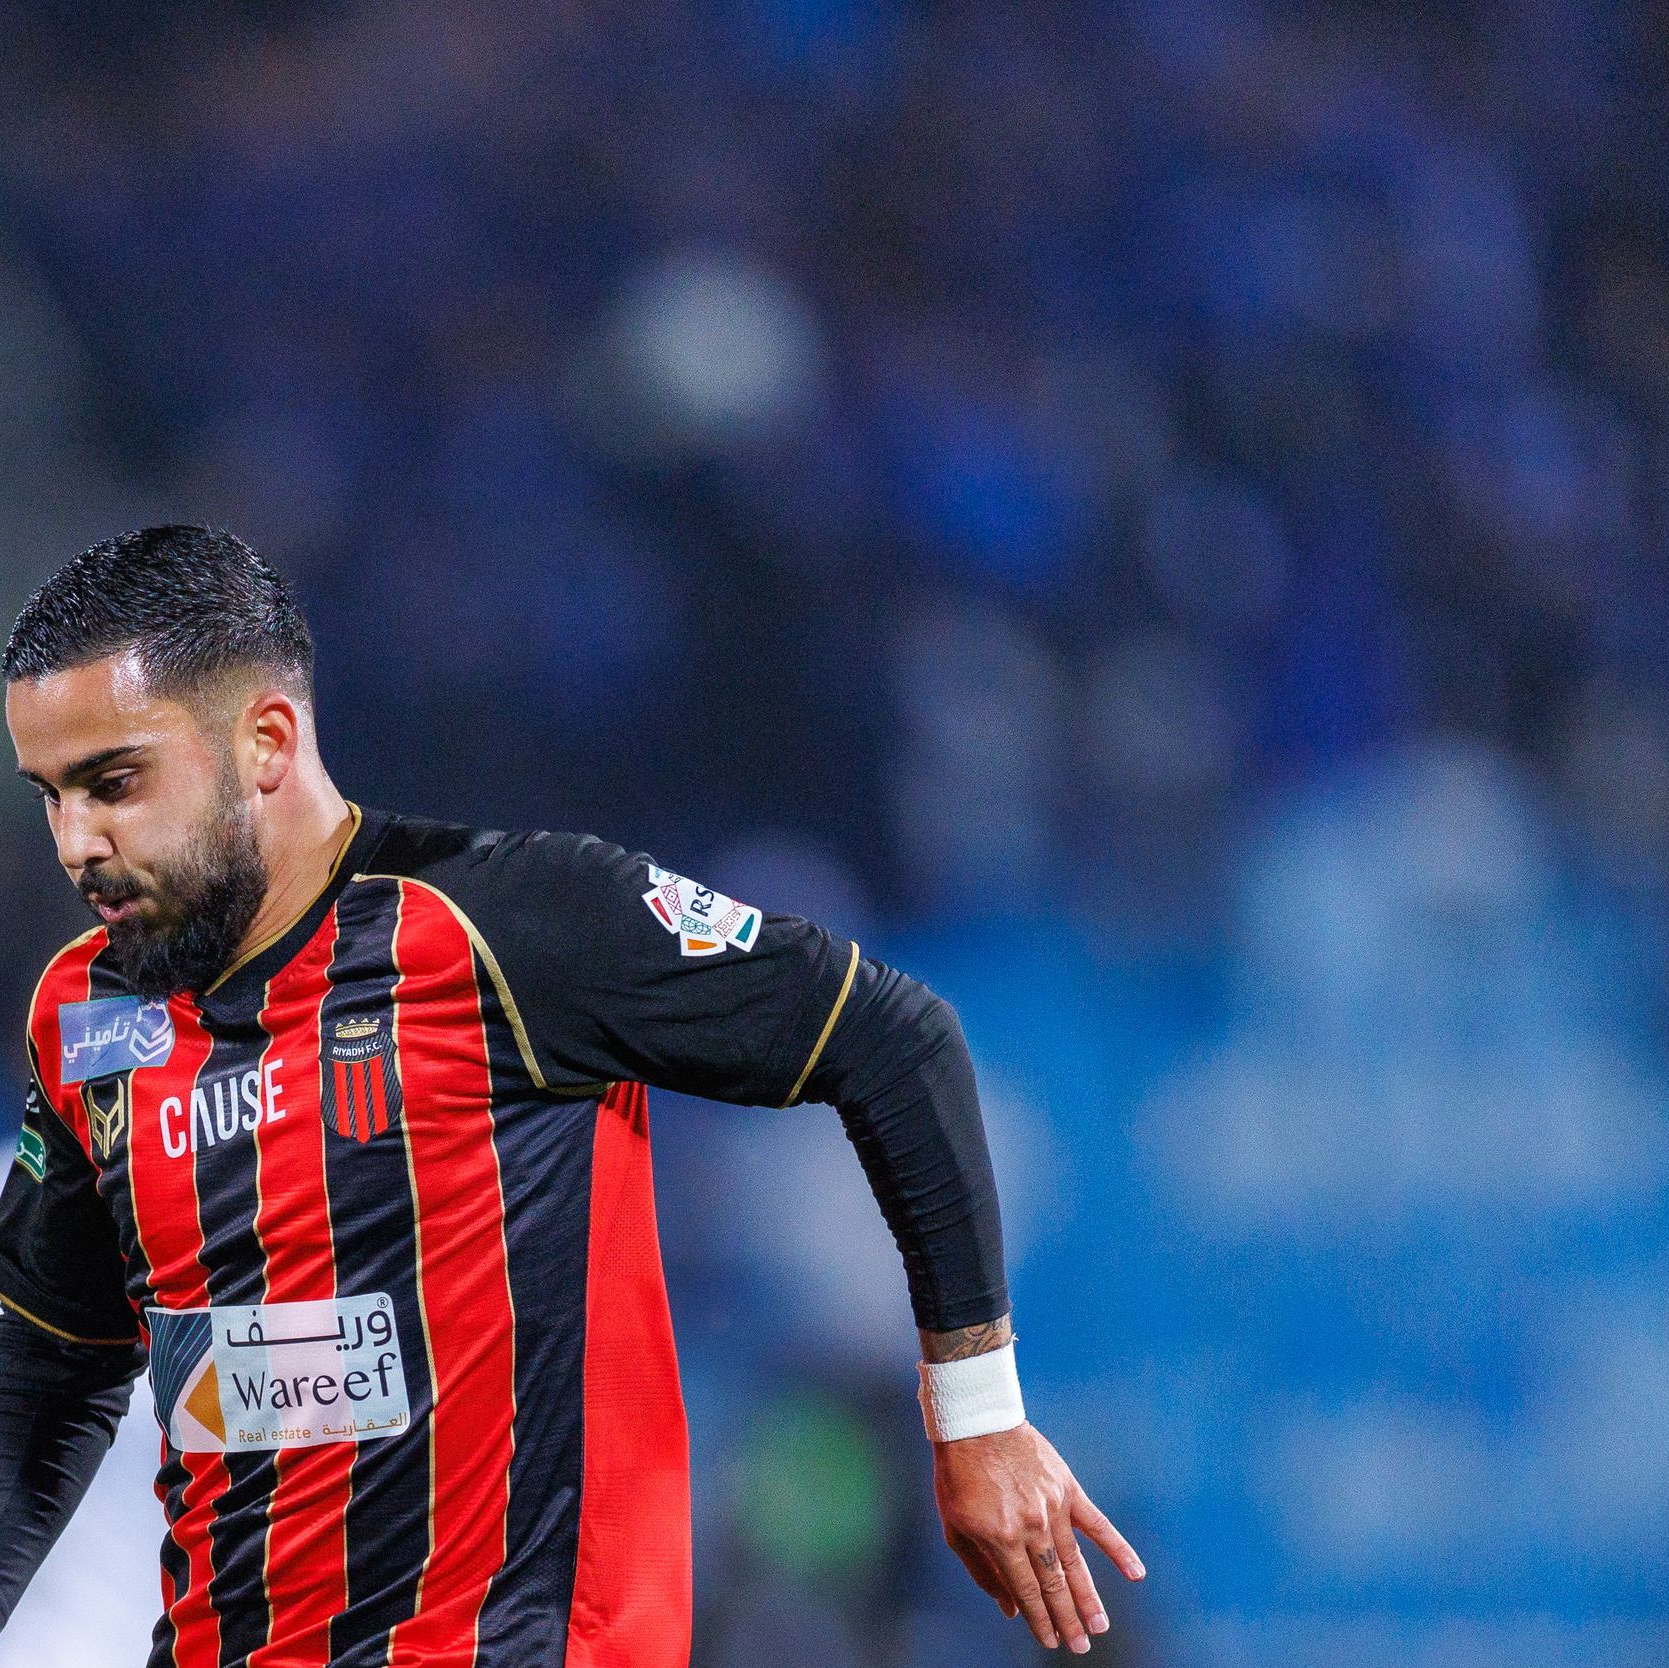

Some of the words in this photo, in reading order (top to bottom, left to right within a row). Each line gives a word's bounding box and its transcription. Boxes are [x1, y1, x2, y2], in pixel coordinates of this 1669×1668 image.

[63, 1015, 132, 1064] تأميني
[332, 1046, 365, 1057] RIYADH
[365, 1041, 383, 1054] F.C.
[159, 1058, 287, 1159] CAUSE
[226, 1309, 393, 1352] وريف
[232, 1351, 398, 1412] Wareef
[239, 1428, 267, 1443] Real
[271, 1426, 312, 1441] estate
